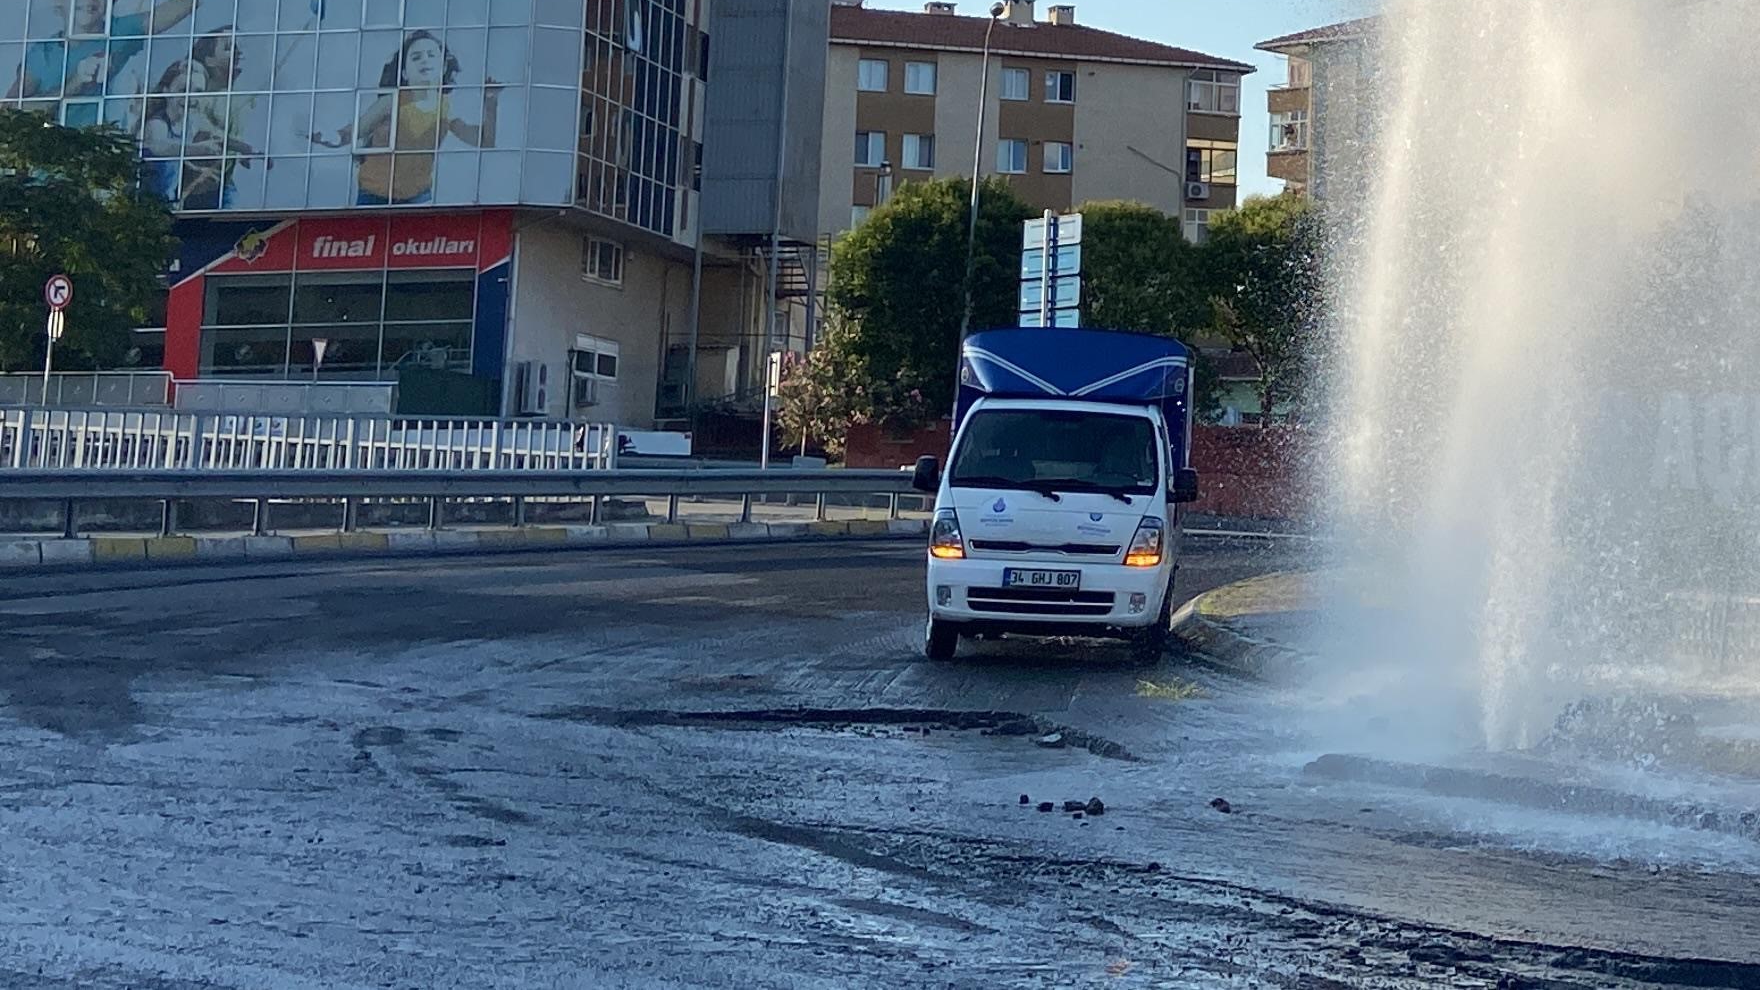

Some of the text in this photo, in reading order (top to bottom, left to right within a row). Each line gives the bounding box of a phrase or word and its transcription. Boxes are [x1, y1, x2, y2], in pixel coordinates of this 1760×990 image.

[312, 234, 475, 259] final okulları
[1010, 571, 1078, 586] 34 GHJ 807
